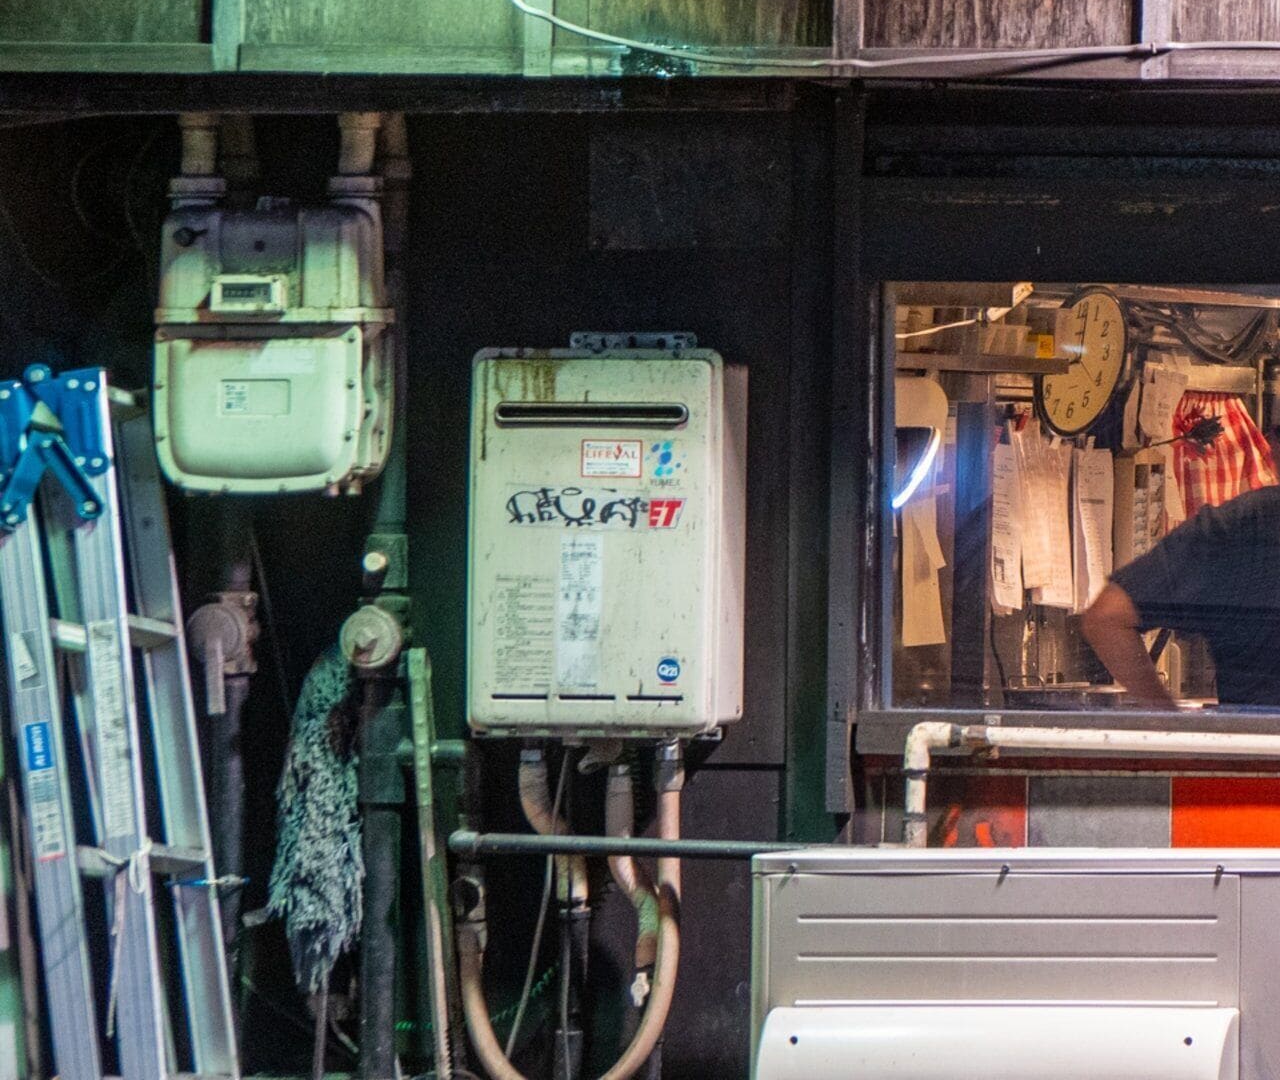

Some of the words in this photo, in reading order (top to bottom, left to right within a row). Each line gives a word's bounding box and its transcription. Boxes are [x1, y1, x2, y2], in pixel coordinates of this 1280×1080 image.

[1100, 320, 1110, 338] 2
[1102, 343, 1110, 361] 3
[1052, 398, 1061, 416] 7
[1081, 390, 1090, 408] 5
[1065, 401, 1075, 419] 6
